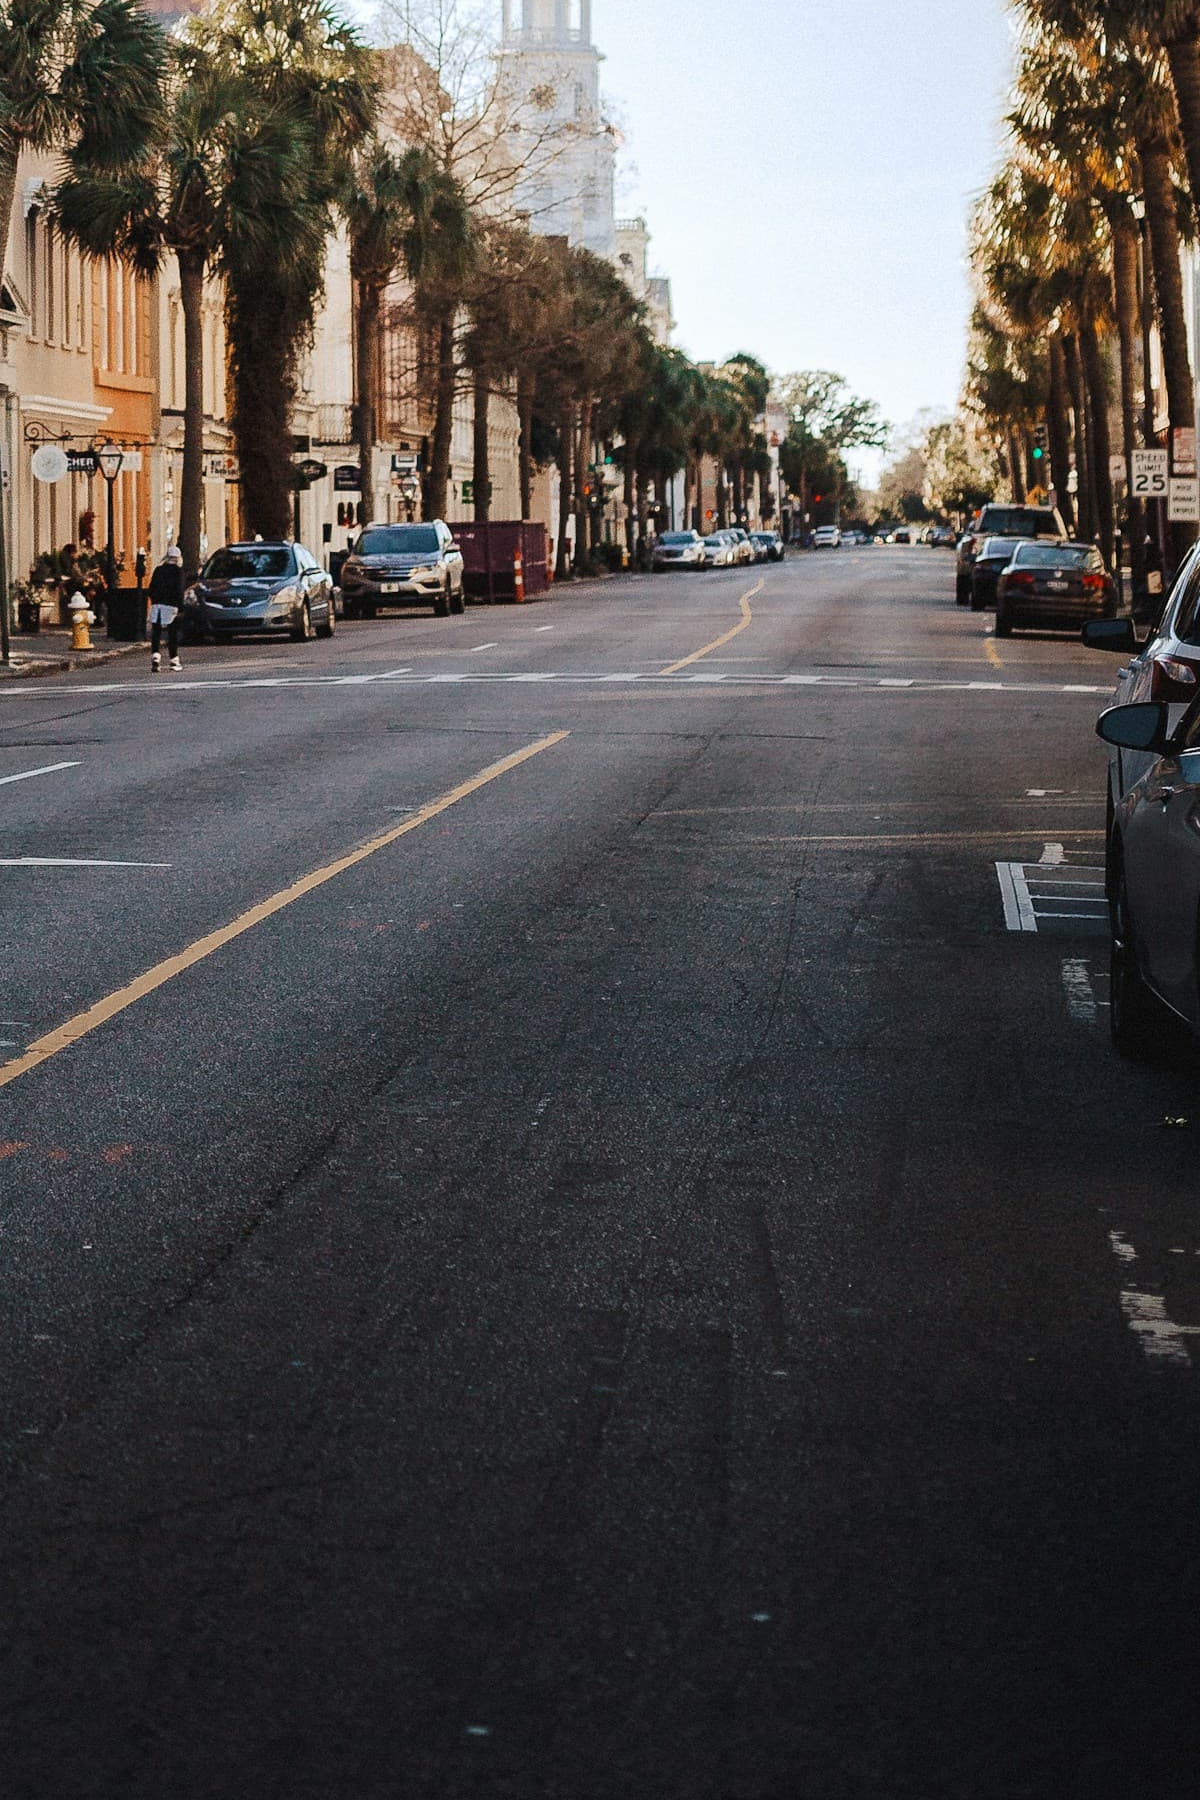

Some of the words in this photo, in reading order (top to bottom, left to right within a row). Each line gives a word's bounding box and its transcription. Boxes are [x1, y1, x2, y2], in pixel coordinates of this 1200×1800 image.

[1135, 454, 1166, 463] SPEED
[1138, 464, 1162, 472] LIMIT
[1136, 474, 1166, 492] 25
